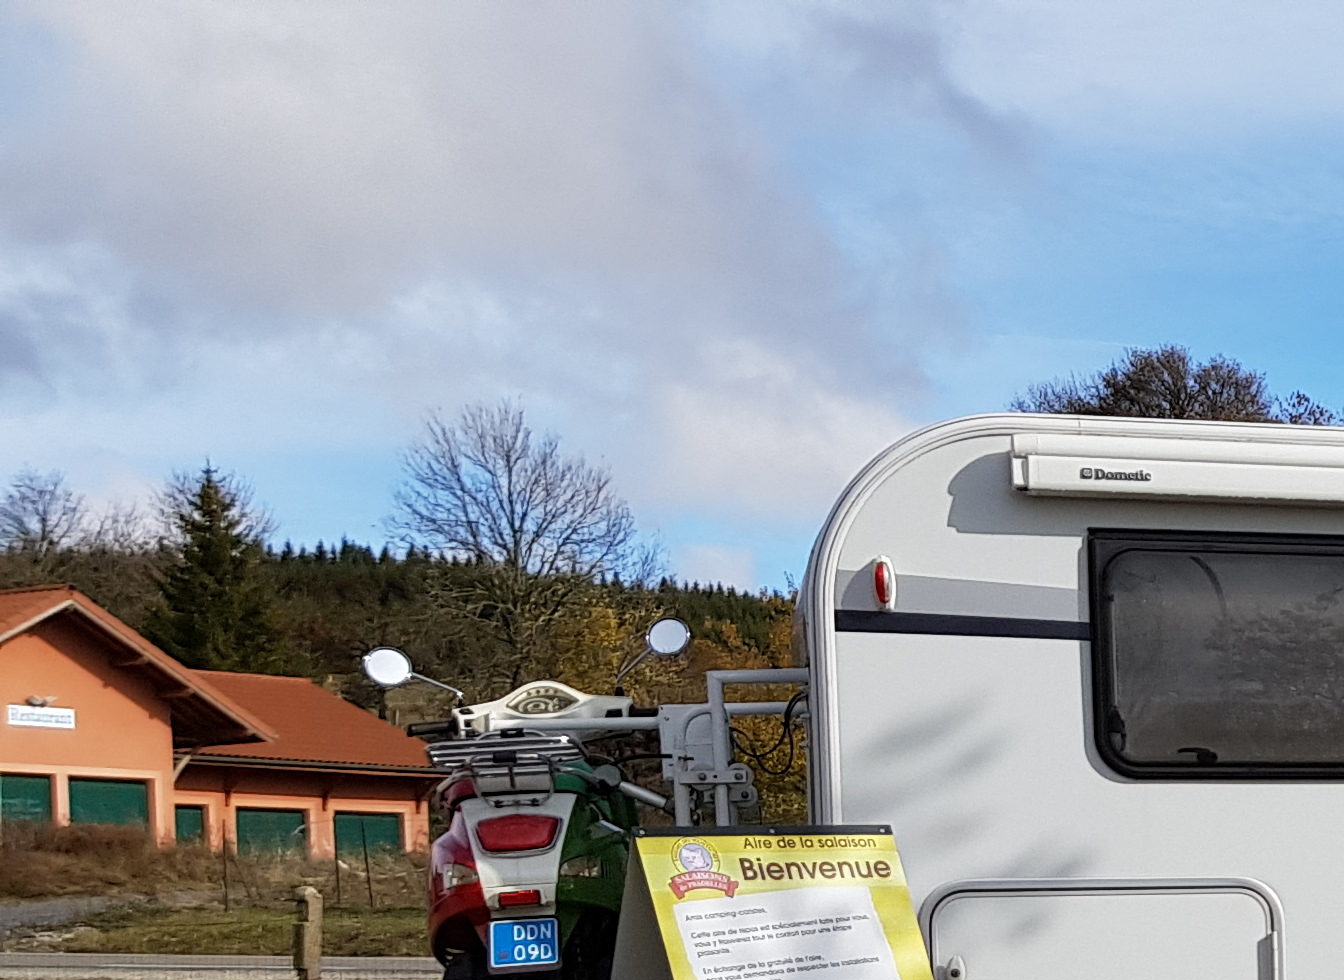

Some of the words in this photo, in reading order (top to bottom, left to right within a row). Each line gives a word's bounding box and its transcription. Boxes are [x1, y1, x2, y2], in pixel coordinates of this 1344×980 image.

[1094, 469, 1151, 481] Dometic
[743, 837, 772, 850] Aire
[777, 836, 796, 849] de
[801, 836, 814, 848] la
[818, 835, 877, 849] salaison
[738, 856, 892, 881] Bienvenue
[513, 922, 552, 941] DDN
